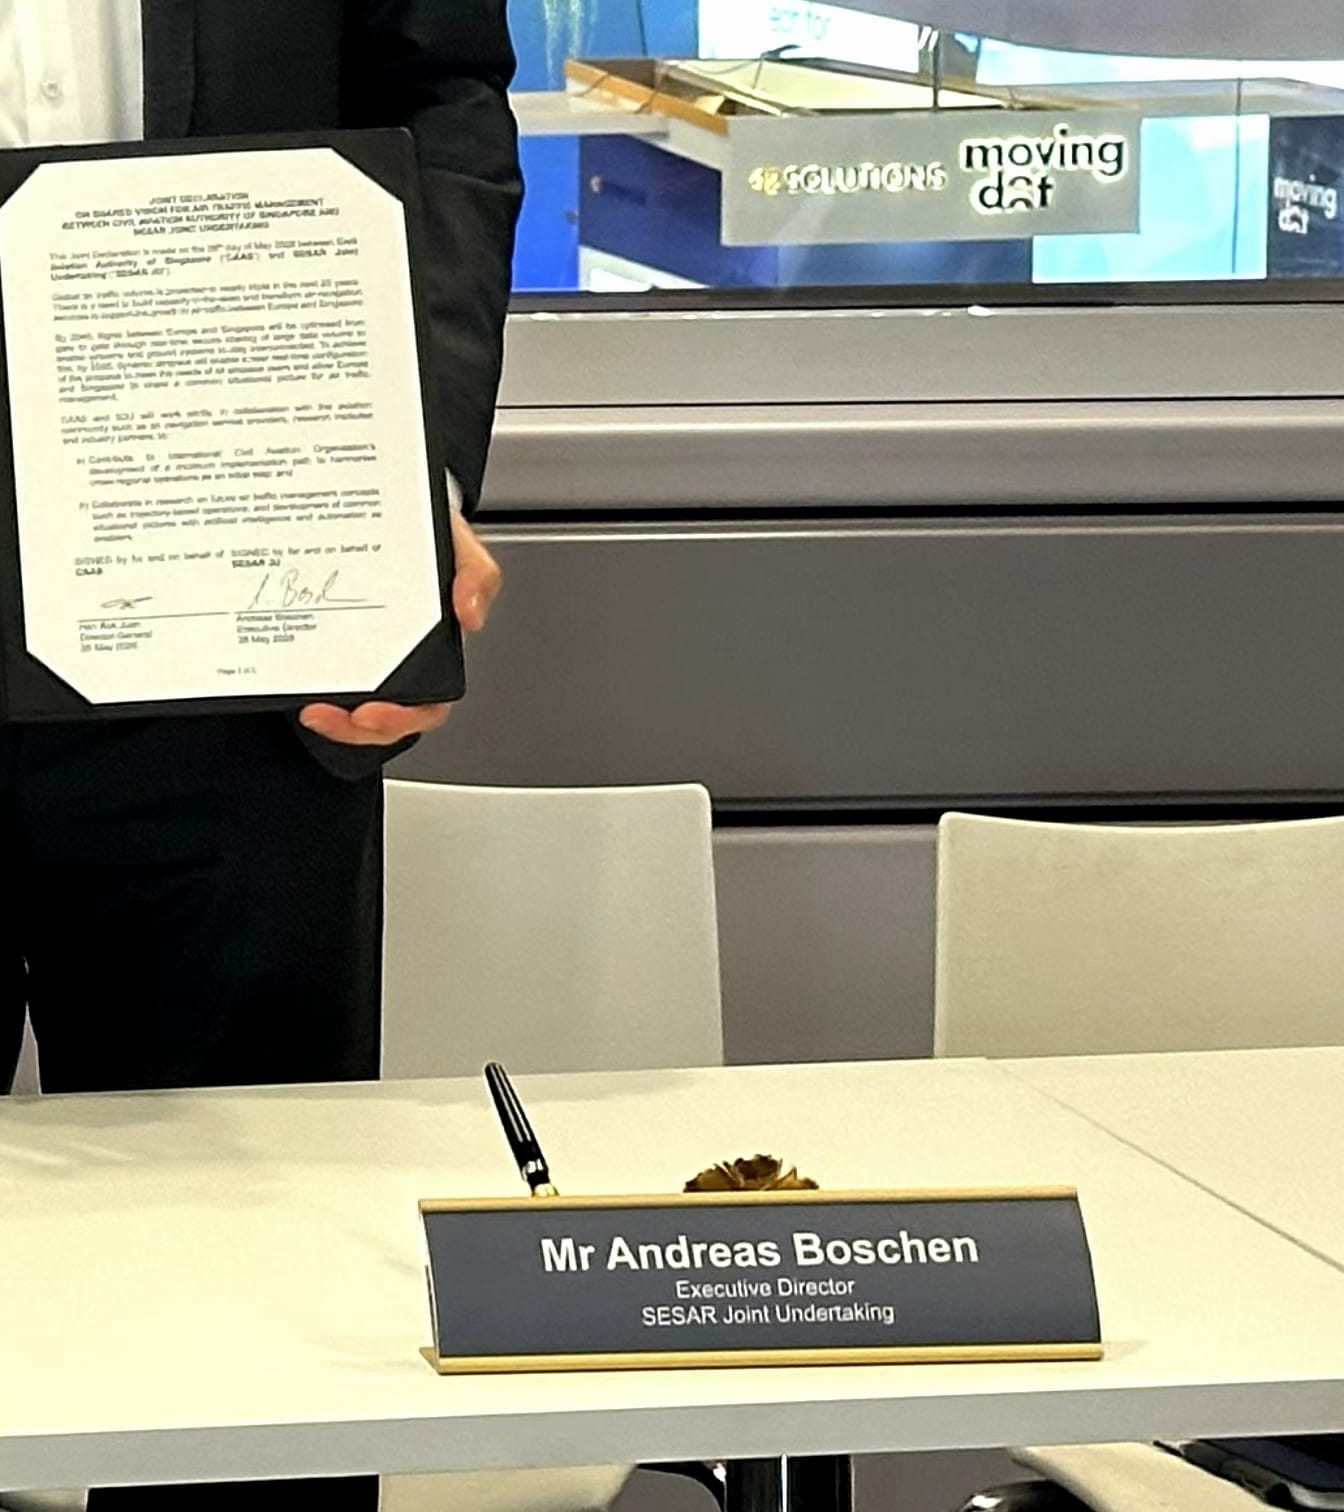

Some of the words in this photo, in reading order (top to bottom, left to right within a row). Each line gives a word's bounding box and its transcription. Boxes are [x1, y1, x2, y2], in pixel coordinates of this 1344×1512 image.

[965, 126, 1126, 178] moving
[1274, 174, 1337, 219] moving
[541, 1238, 595, 1272] Mr
[607, 1235, 781, 1270] Andreas
[792, 1230, 979, 1266] Boschen
[676, 1280, 772, 1299] Executive
[777, 1277, 855, 1297] Director
[641, 1306, 718, 1327] SESAR
[723, 1304, 771, 1324] Joint
[776, 1301, 896, 1325] Undertaking
